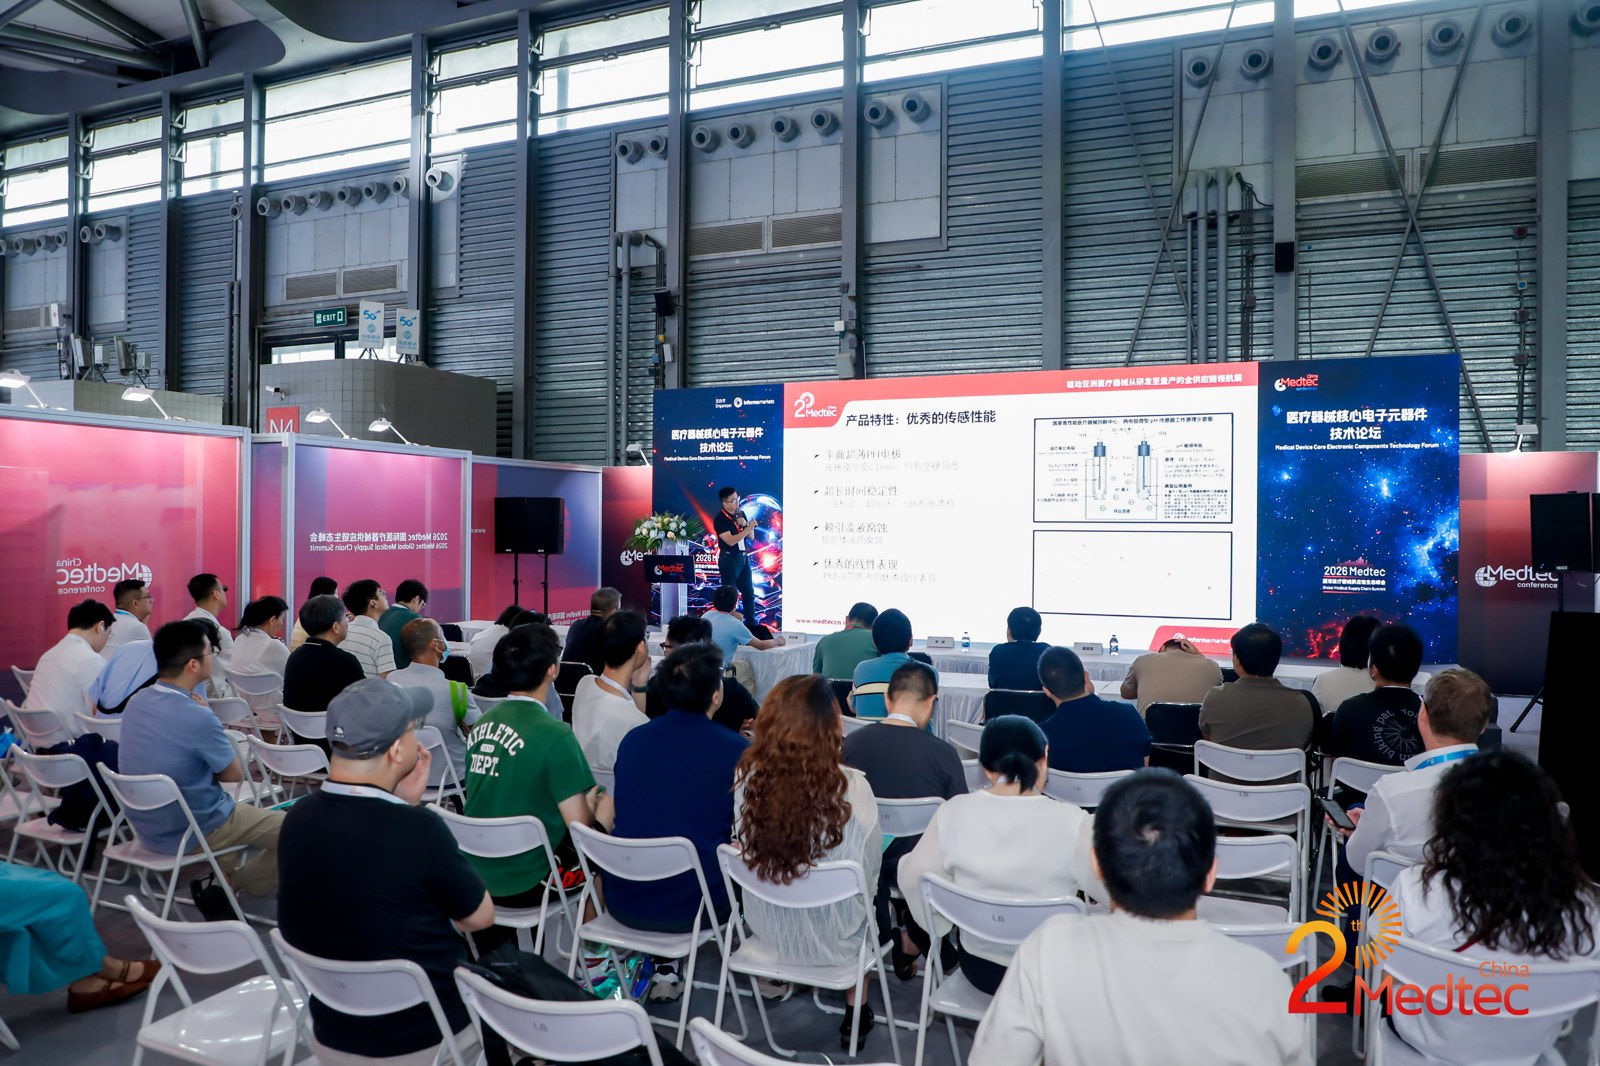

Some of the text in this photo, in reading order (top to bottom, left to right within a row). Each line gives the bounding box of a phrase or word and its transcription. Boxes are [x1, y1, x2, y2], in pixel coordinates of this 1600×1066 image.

[323, 314, 336, 322] EXIT
[1282, 377, 1318, 387] Medtec
[806, 408, 837, 417] Medtec
[1287, 408, 1428, 424] 医疗器械核心电子元器件
[672, 427, 764, 441] 医疗器械核心电子元器件
[1330, 427, 1382, 440] 技术论坛
[700, 442, 734, 453] 技术论坛
[1324, 566, 1386, 576] 2026 Medtec
[467, 721, 525, 756] ATHLETIC
[470, 754, 499, 777] DEPT.
[992, 914, 1005, 923] LB
[533, 1022, 548, 1032] LB
